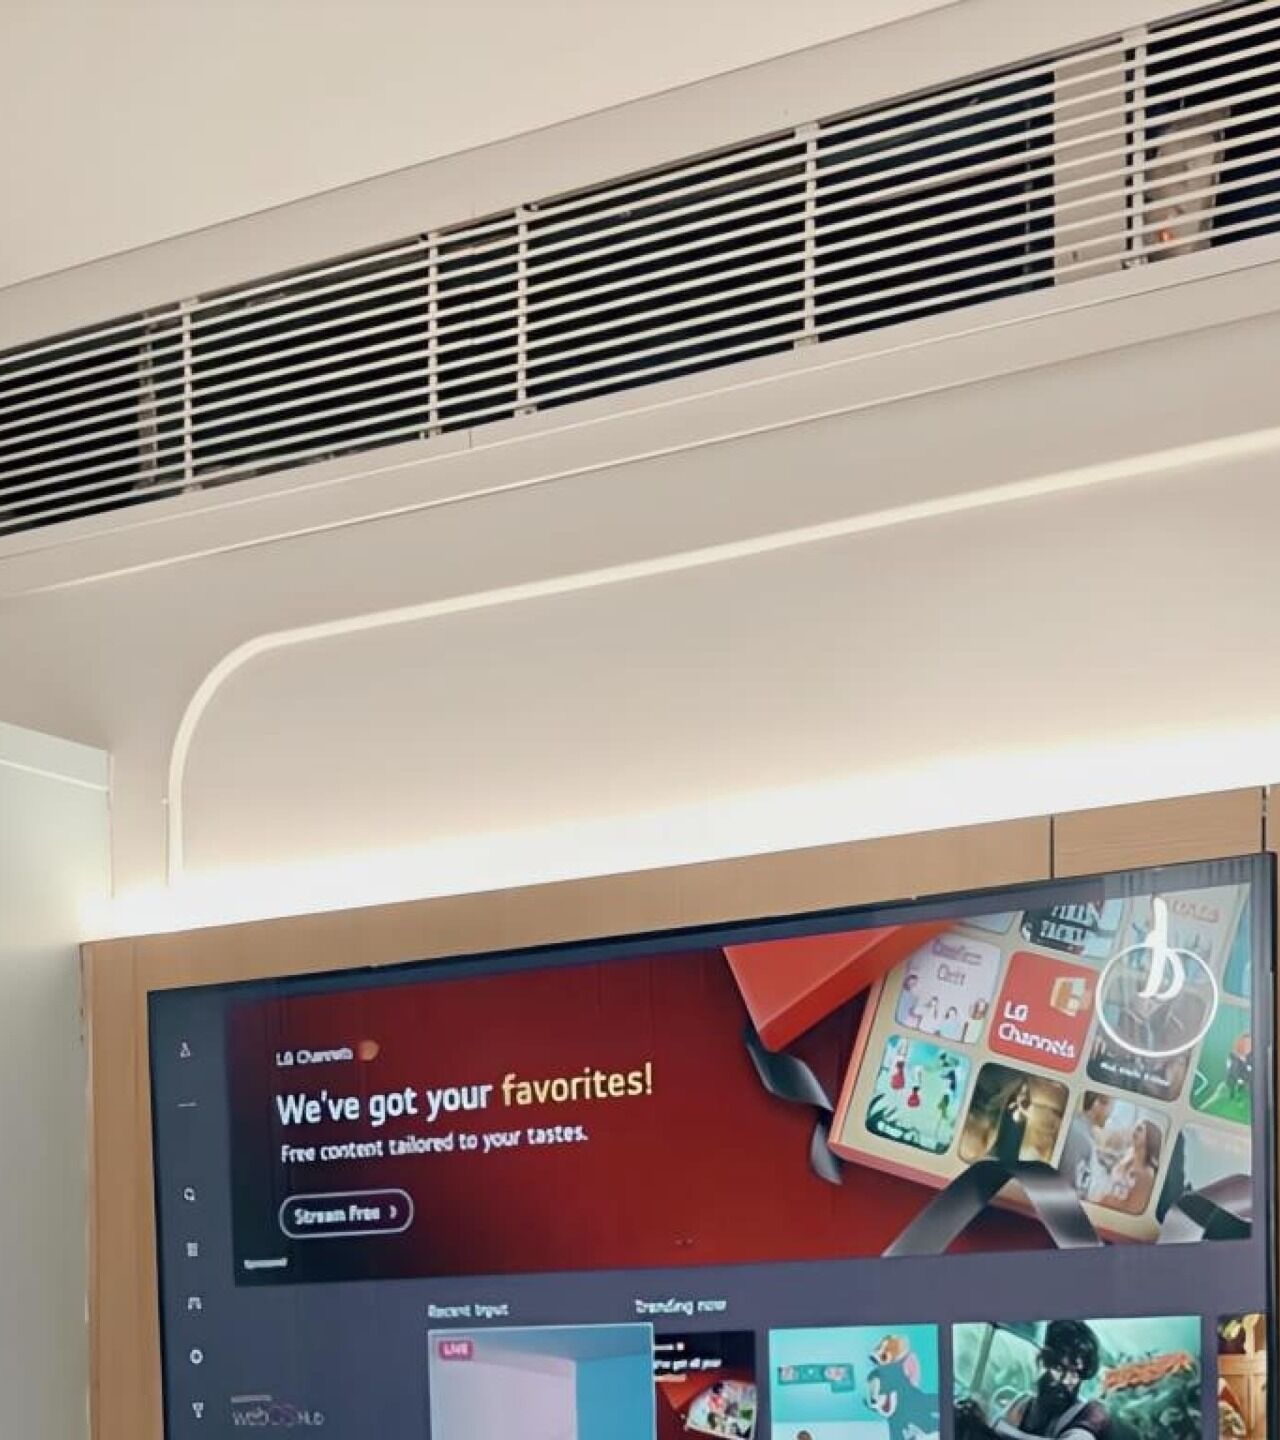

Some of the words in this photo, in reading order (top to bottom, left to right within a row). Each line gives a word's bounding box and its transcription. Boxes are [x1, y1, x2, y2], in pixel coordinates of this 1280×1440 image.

[998, 1023, 1076, 1059] Channels
[275, 1088, 361, 1126] We've
[369, 1087, 418, 1127] got
[426, 1083, 493, 1123] your
[501, 1062, 653, 1107] favorites!
[280, 1144, 316, 1163] Free
[320, 1141, 384, 1161] content
[388, 1132, 454, 1156] tailored
[458, 1132, 478, 1150] to
[482, 1130, 521, 1154] your
[526, 1124, 589, 1145] tastes.
[293, 1208, 346, 1226] Stream
